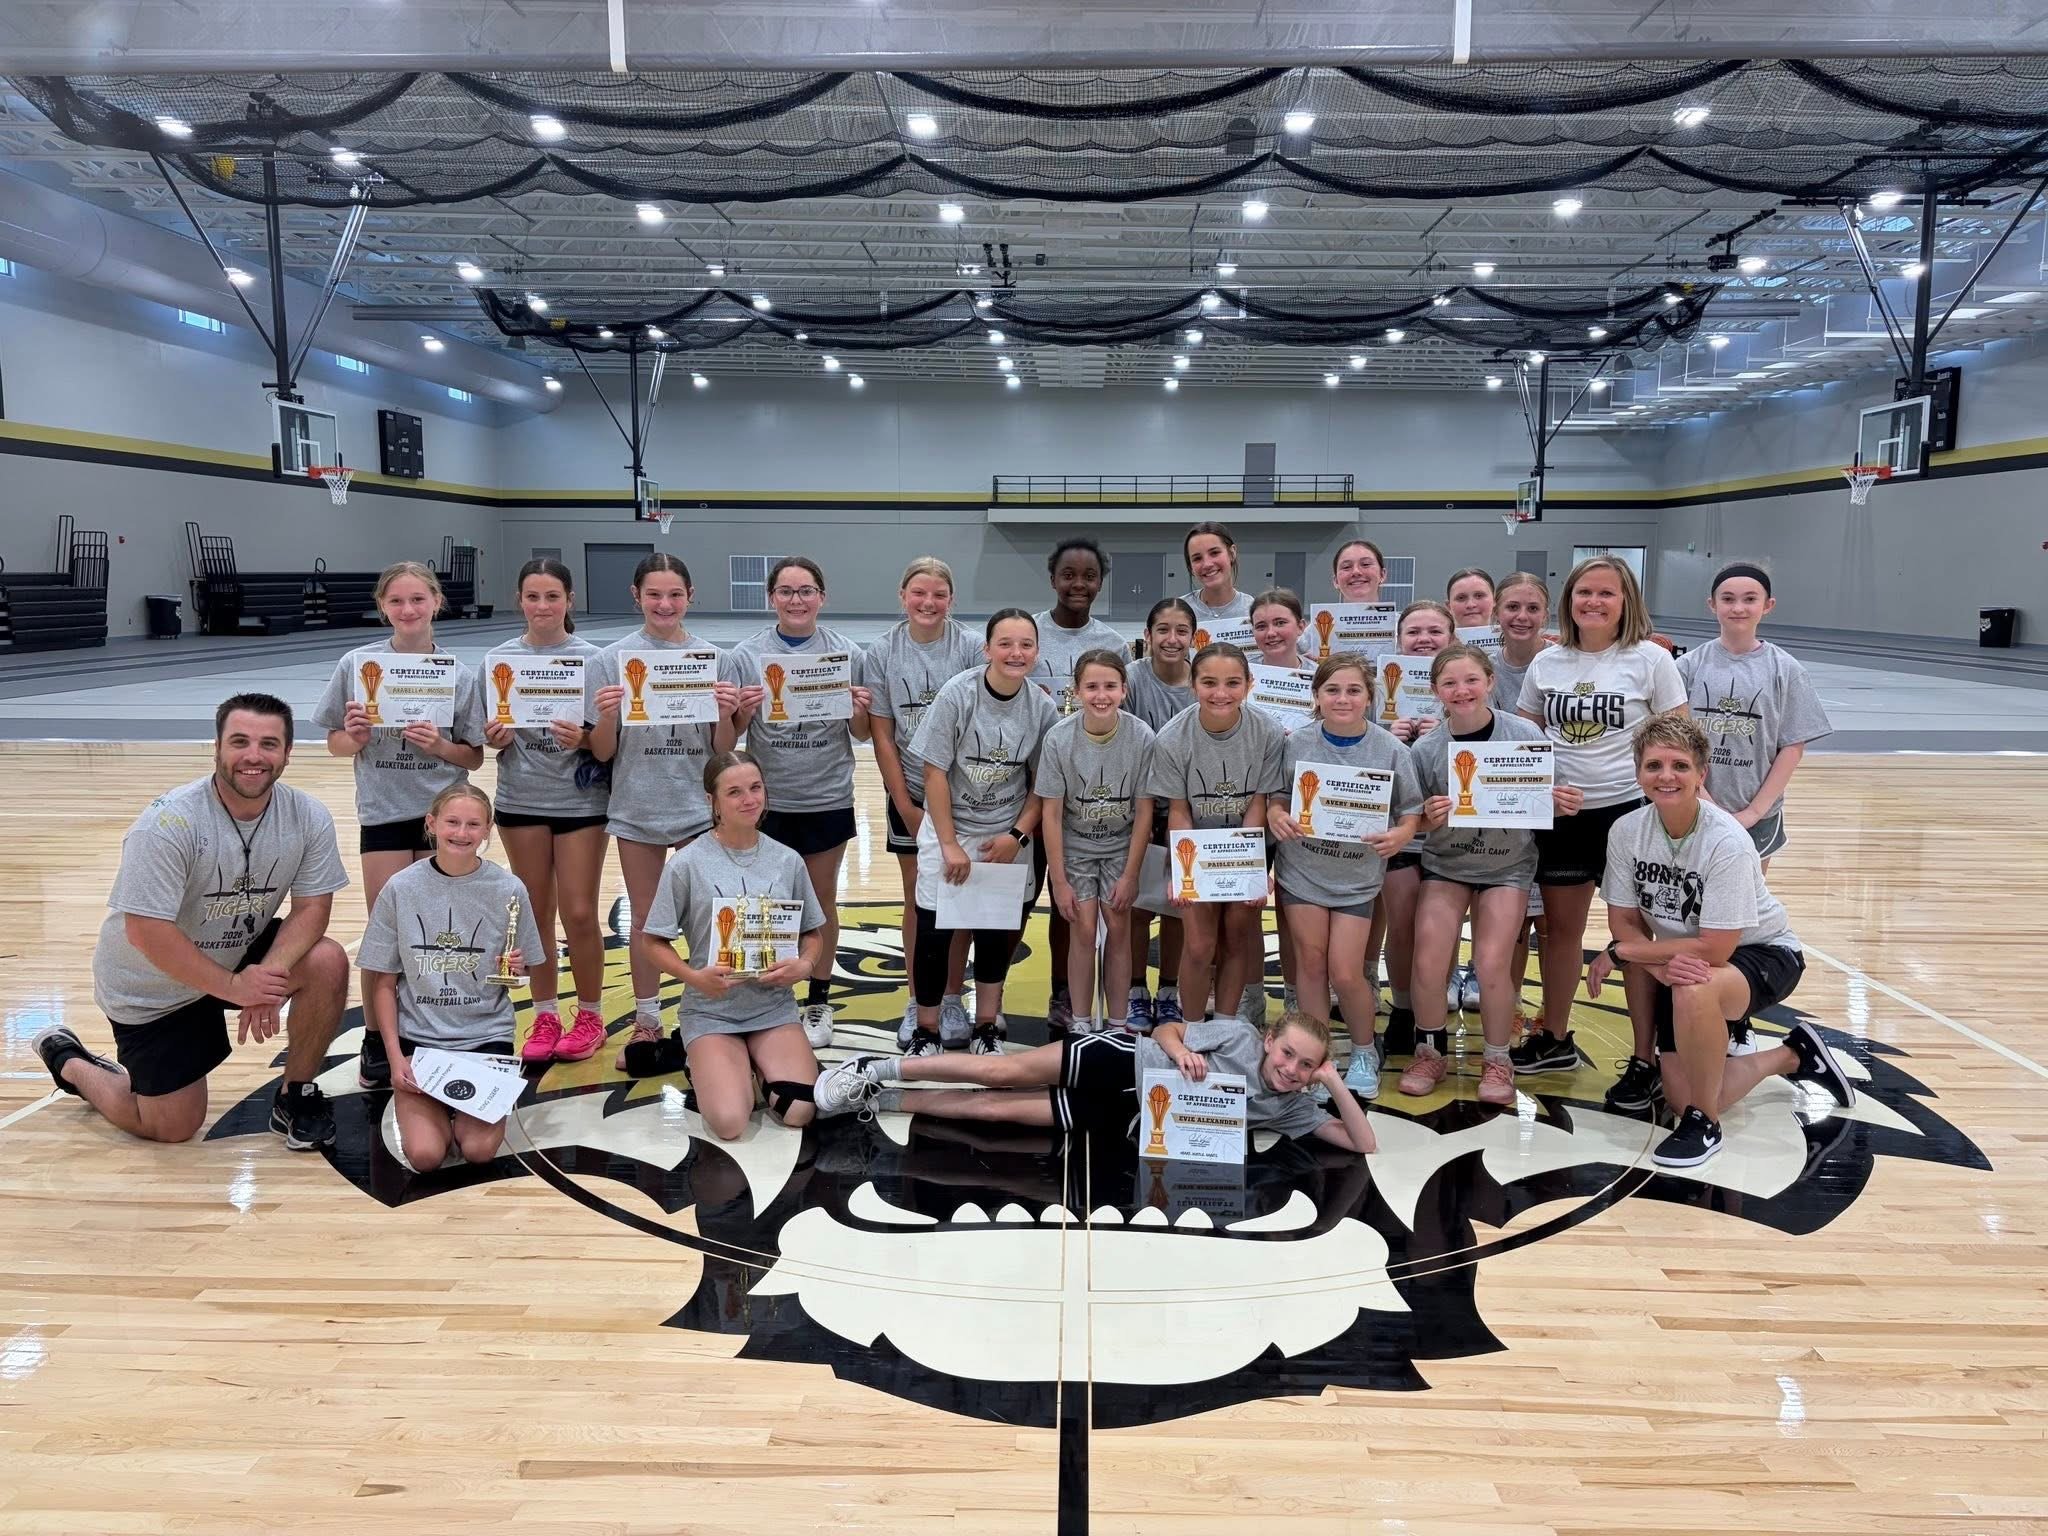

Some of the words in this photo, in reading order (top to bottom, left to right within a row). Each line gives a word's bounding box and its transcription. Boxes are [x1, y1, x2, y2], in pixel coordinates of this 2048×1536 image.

[791, 666, 842, 674] CERTIFICATE
[1260, 679, 1310, 690] CERTIFICATE
[1547, 694, 1625, 729] TIGERS
[771, 740, 810, 749] BASKETBALL
[644, 748, 685, 756] BASKETBALL
[1713, 748, 1731, 756] 2026
[375, 761, 416, 770] BASKETBALL
[418, 762, 438, 770] CAMP
[1734, 759, 1753, 767] CAMP
[1326, 780, 1381, 791] CERTIFICATE
[1350, 802, 1381, 810] BRADLEY
[1321, 840, 1340, 849] 2026
[1301, 842, 1340, 858] BASKETBALL
[1342, 852, 1364, 860] CAMP
[204, 894, 272, 920] TIGERS
[222, 931, 243, 940] 2026
[194, 940, 244, 949] BASKETBALL
[415, 953, 480, 976] TIGERS
[440, 988, 457, 996] 2026
[416, 996, 461, 1006] BASKETBALL
[1178, 1094, 1236, 1104] CERTIFICATE
[1197, 1117, 1238, 1125] ALEXANDER
